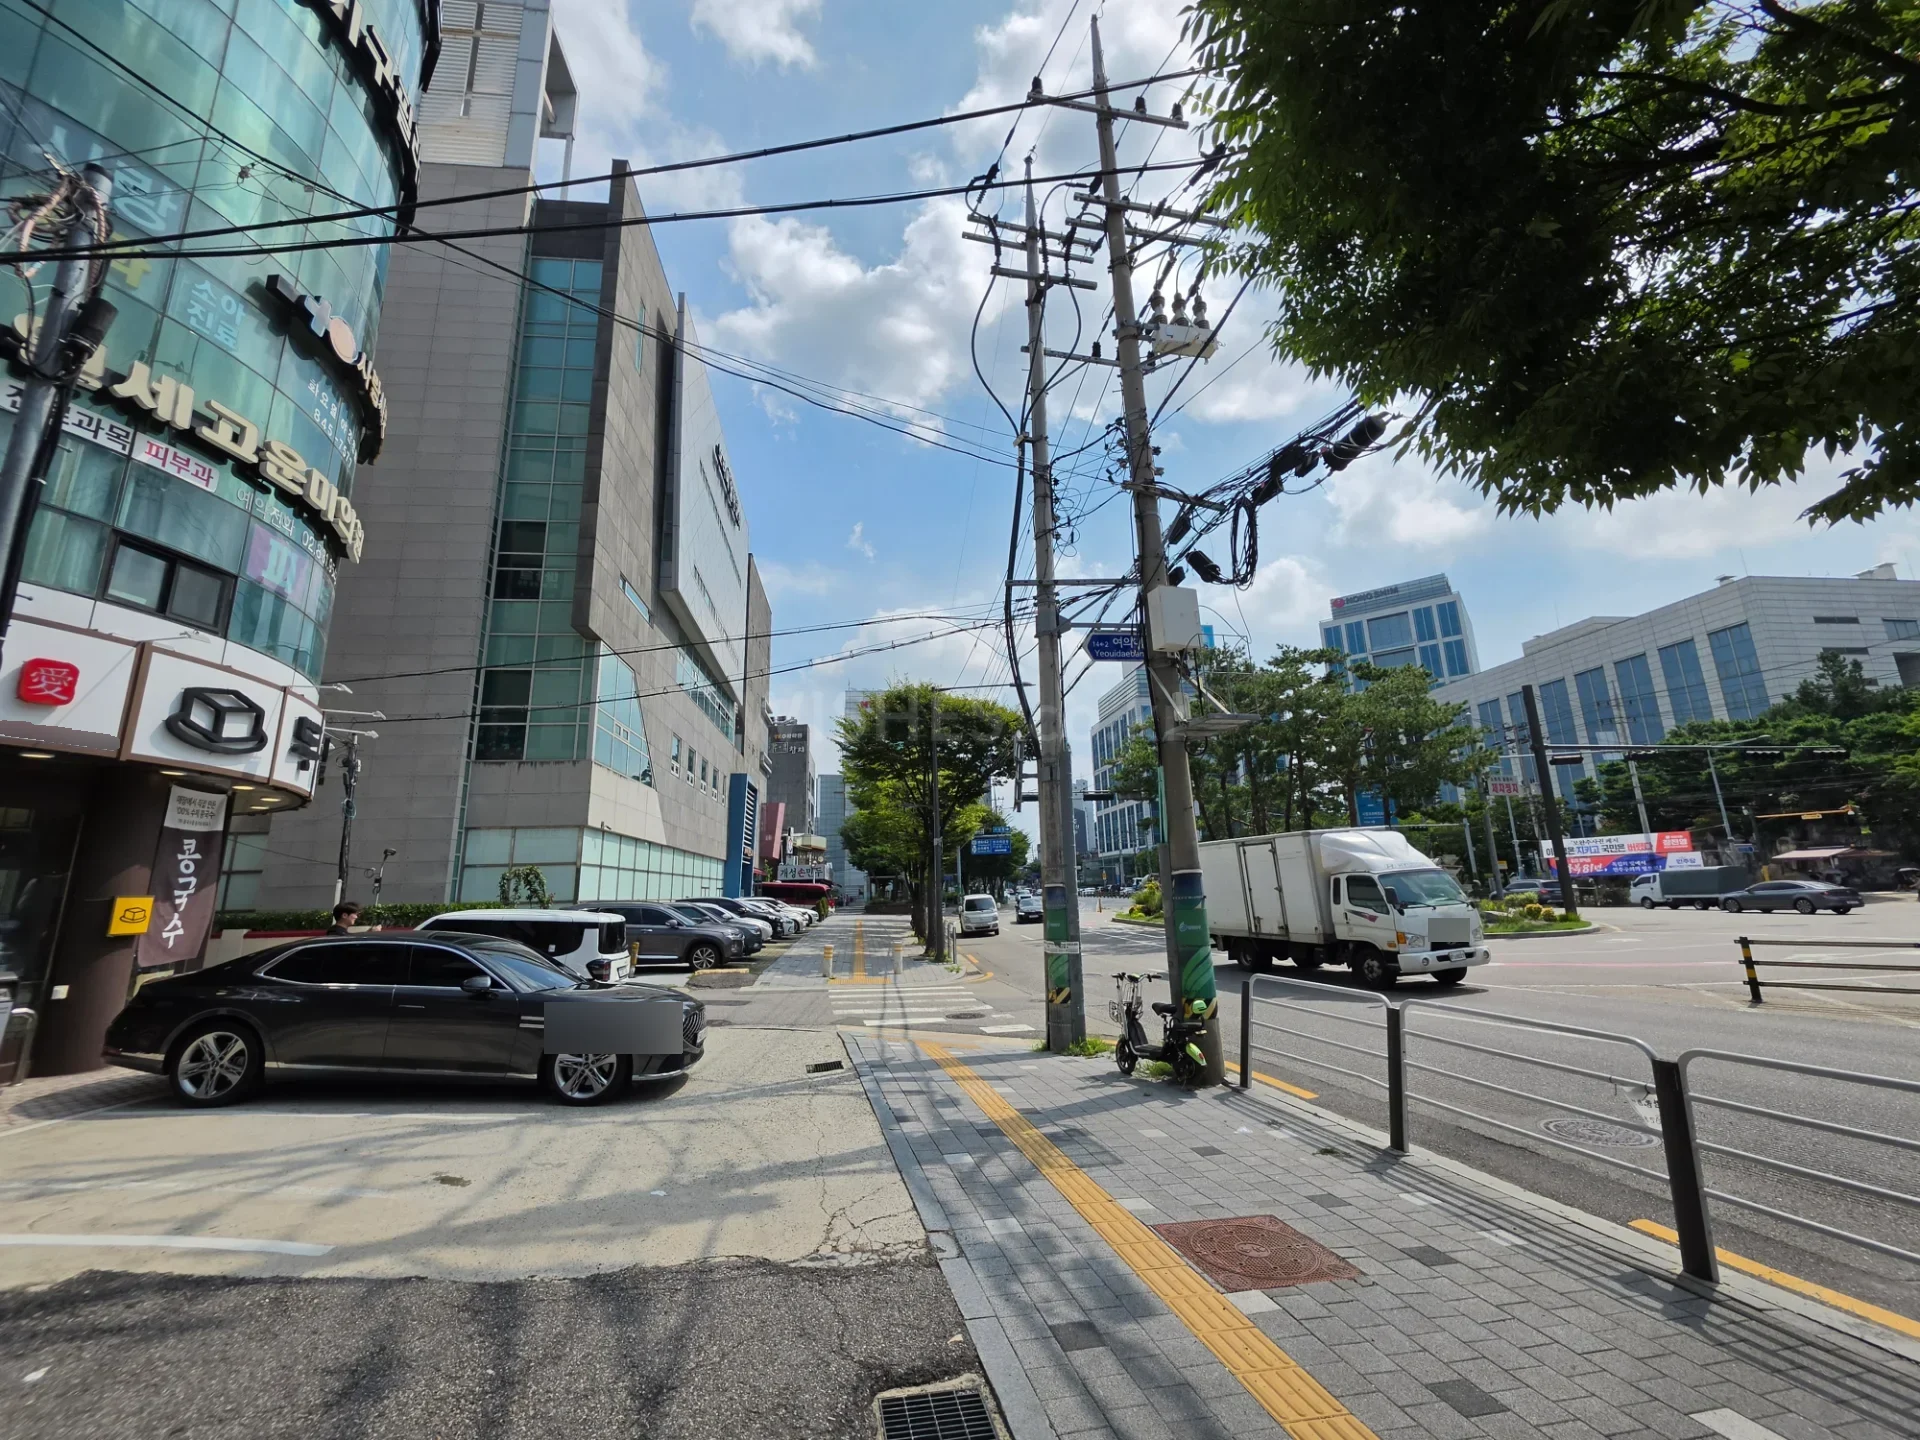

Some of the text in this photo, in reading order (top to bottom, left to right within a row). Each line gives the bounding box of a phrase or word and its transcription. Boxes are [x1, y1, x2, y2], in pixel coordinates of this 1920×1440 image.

[186, 299, 240, 352] 진료
[193, 279, 246, 326] 소아
[146, 440, 214, 488] 피부과
[30, 669, 74, 703] 愛
[1576, 845, 1601, 855] 지키고
[1601, 843, 1625, 854] 국민은
[161, 838, 202, 949] 콩국수
[780, 867, 824, 879] 개성손만두
